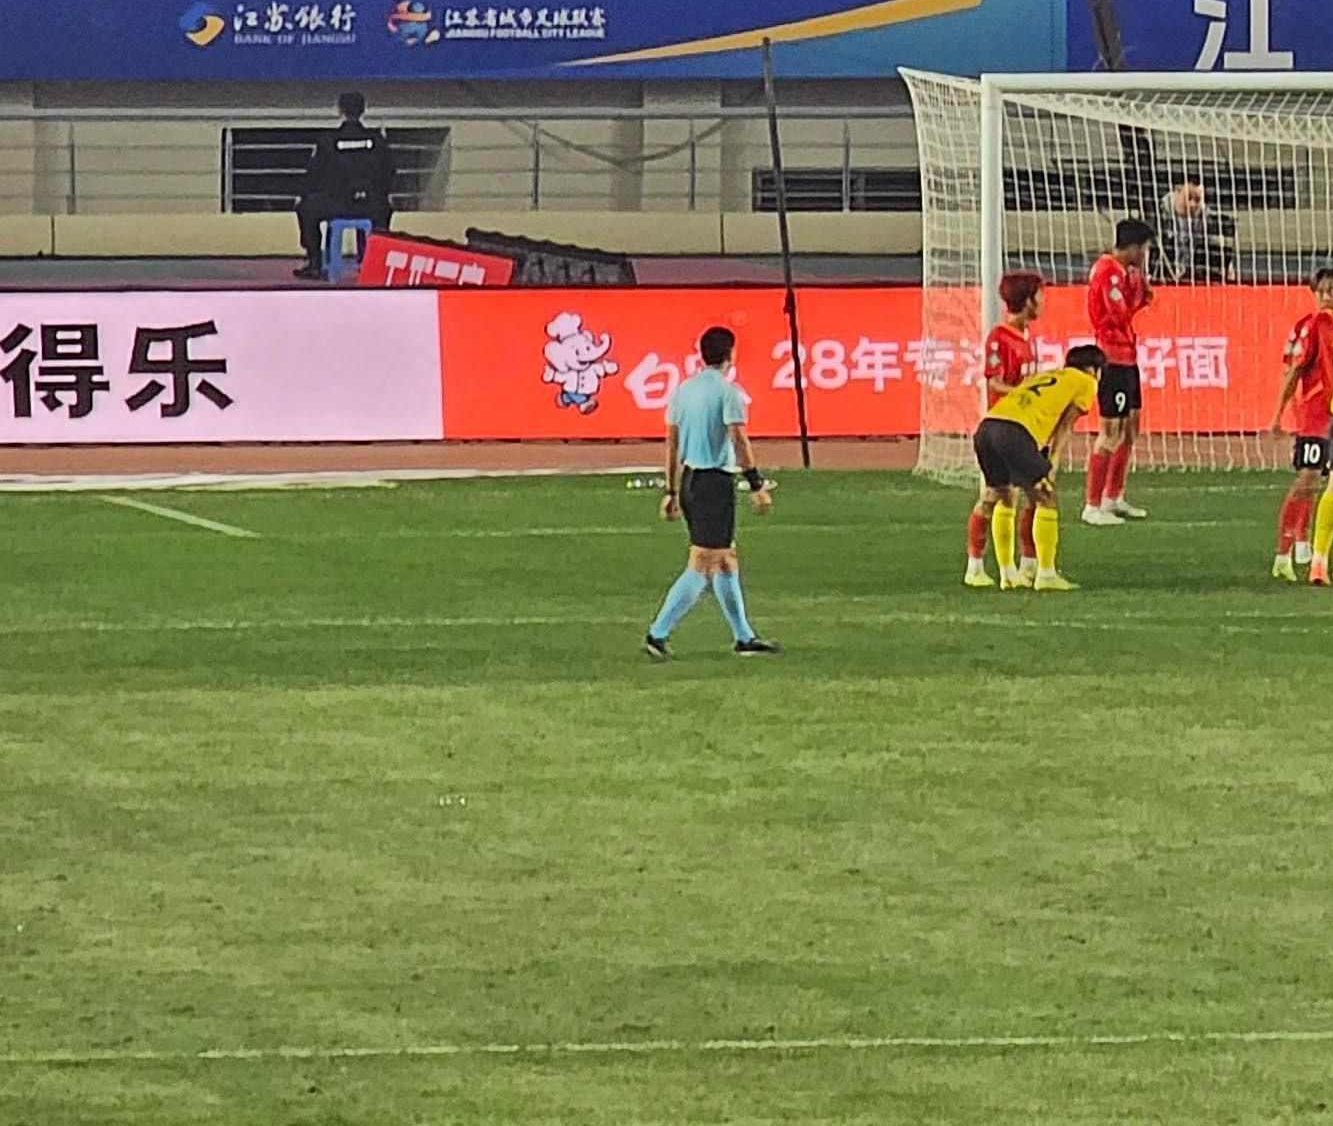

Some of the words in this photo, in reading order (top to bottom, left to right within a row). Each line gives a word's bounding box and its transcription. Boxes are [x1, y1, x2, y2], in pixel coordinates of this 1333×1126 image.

[233, 0, 357, 32] 江苏银行
[0, 320, 234, 419] 得乐
[1114, 391, 1127, 413] 9
[1303, 443, 1321, 464] 10
